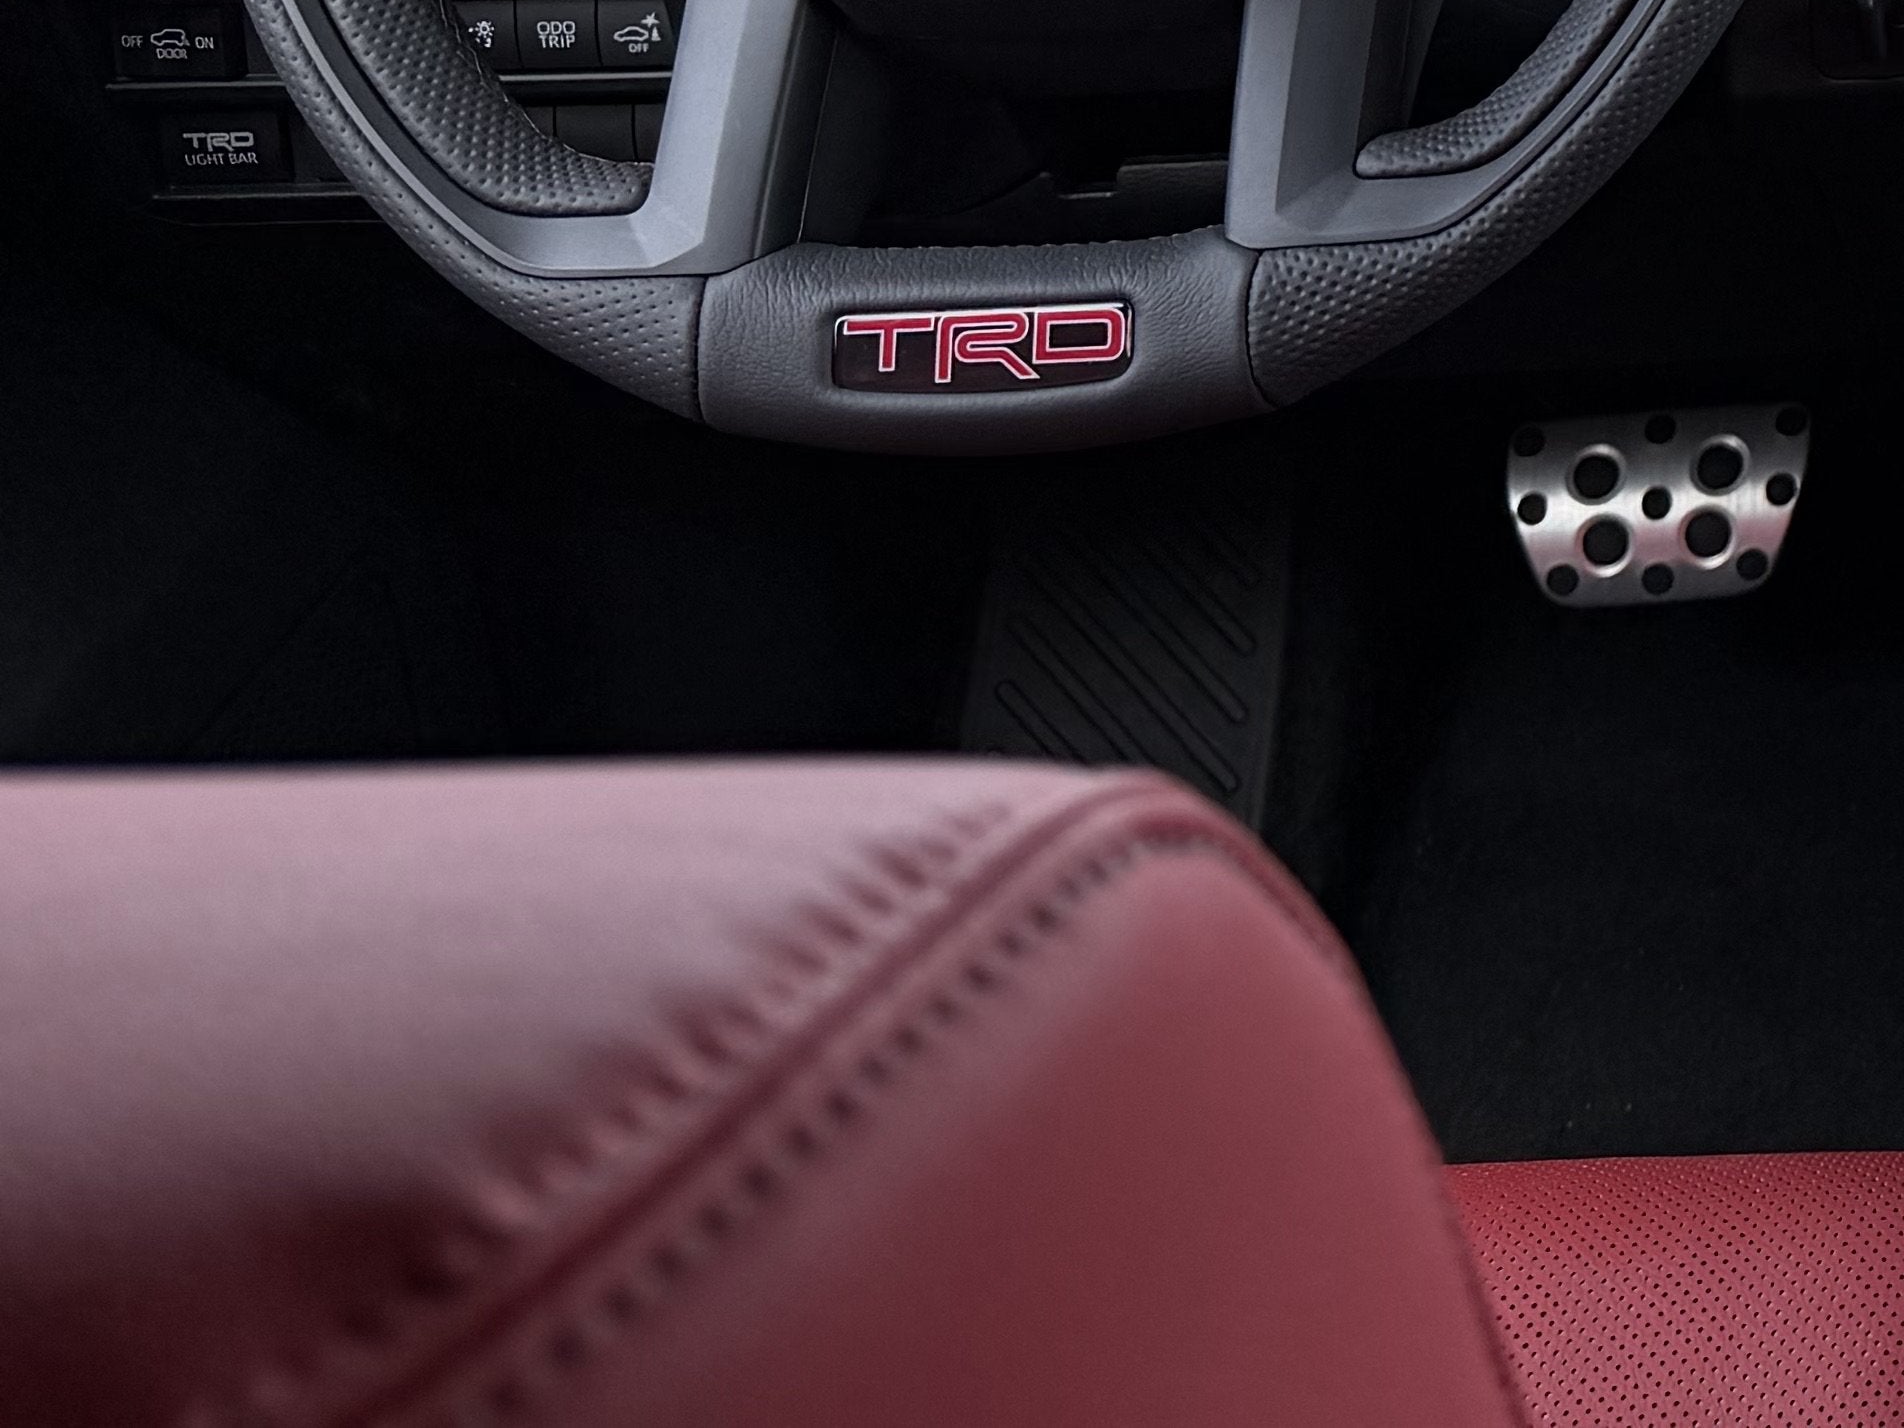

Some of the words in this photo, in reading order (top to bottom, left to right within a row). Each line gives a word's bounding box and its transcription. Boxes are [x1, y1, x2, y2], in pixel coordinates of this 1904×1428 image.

[536, 20, 577, 35] ODO
[121, 34, 144, 49] OFF
[195, 37, 215, 50] ON
[538, 34, 577, 49] TRIP
[156, 47, 189, 60] DOOR
[182, 131, 255, 152] TRD
[184, 152, 225, 167] LIGHT
[229, 151, 259, 165] BAR
[842, 306, 1126, 385] TRD
